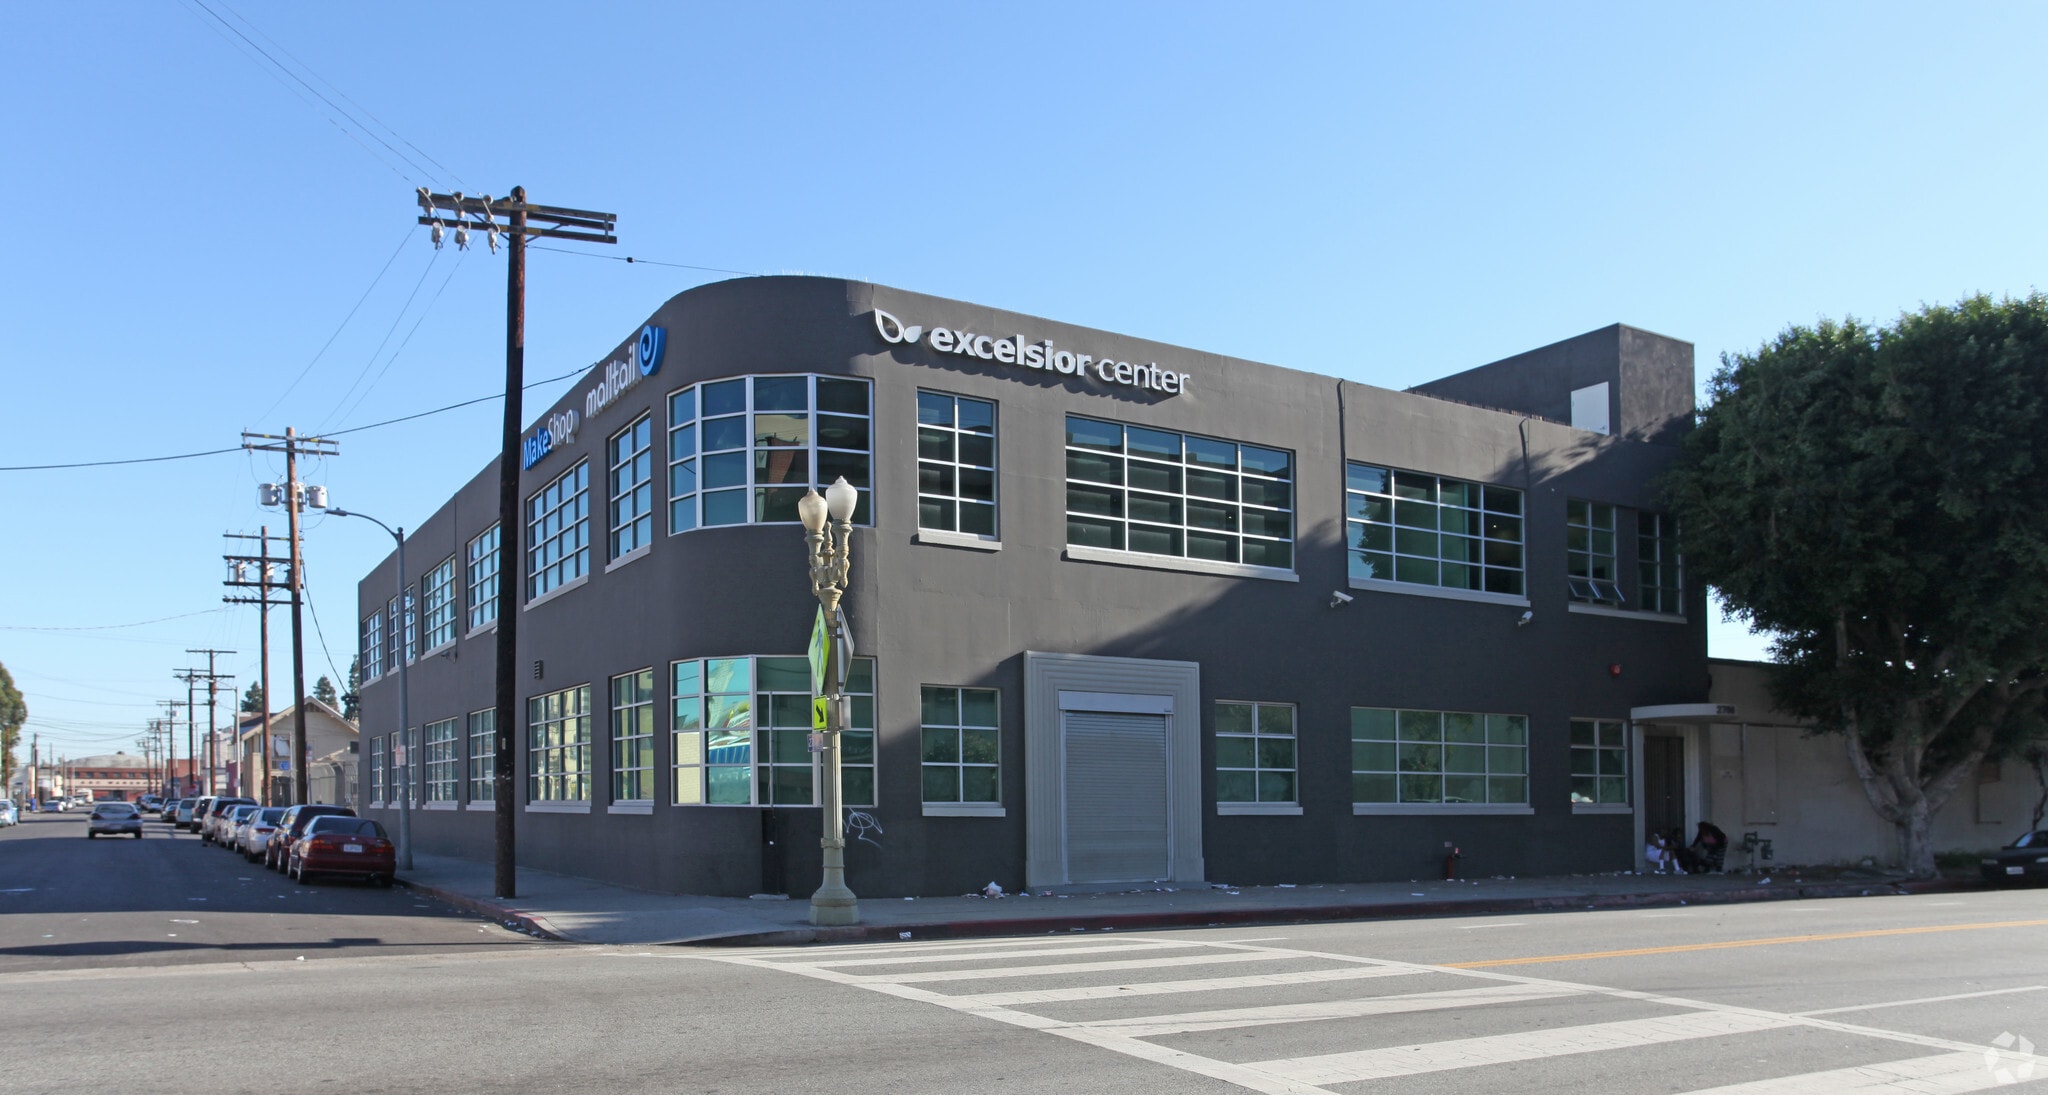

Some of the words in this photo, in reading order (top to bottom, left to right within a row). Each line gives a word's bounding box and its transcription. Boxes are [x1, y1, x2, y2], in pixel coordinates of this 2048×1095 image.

[586, 342, 638, 418] malltail
[930, 326, 1092, 376] excelsior
[1098, 358, 1190, 395] center
[523, 408, 578, 471] MakeShop
